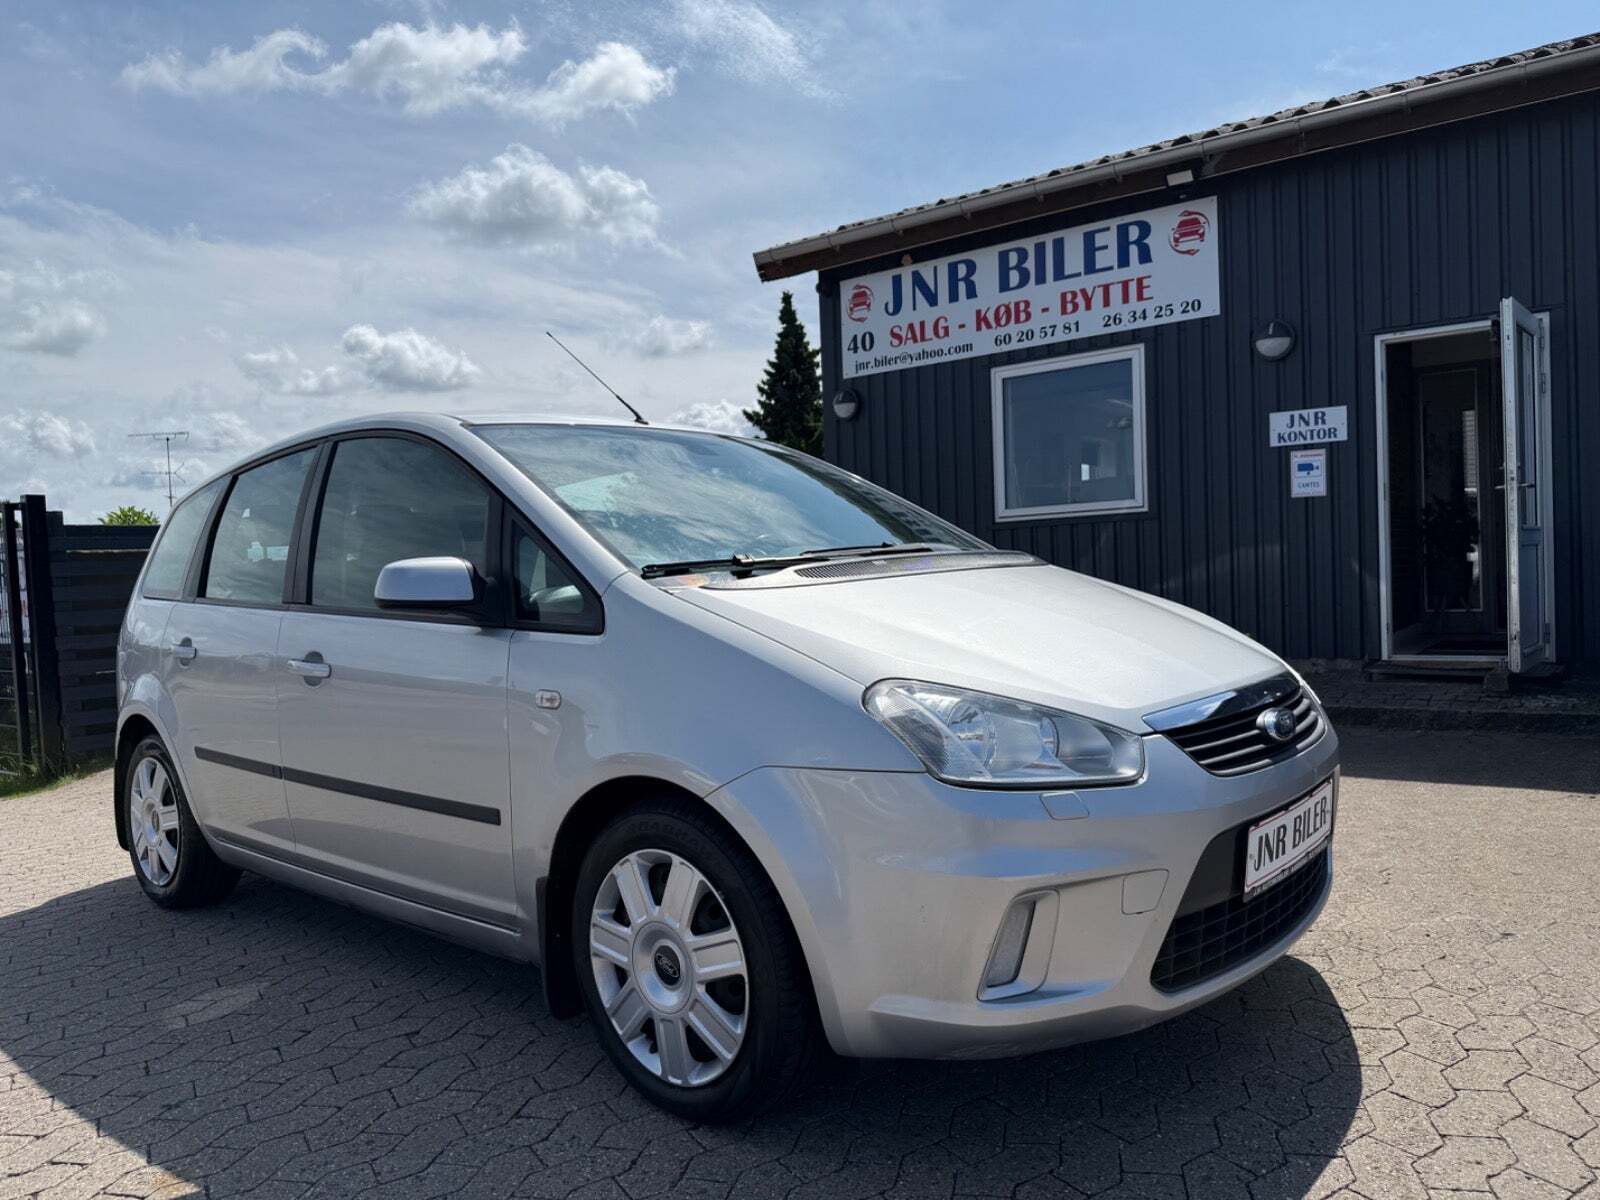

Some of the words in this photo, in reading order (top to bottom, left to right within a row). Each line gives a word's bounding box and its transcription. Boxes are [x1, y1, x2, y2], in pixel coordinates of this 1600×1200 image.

[884, 258, 978, 316] JNR
[998, 220, 1153, 293] BILER
[889, 316, 950, 348] SALG
[975, 299, 1032, 333] KØB
[1060, 275, 1154, 316] BYTTE
[1102, 313, 1122, 328] 26
[1127, 308, 1148, 323] 34
[1153, 303, 1174, 319] 25
[1180, 298, 1202, 314] 20
[847, 331, 875, 354] 40
[994, 333, 1012, 347] 60
[1016, 328, 1034, 343] 20
[1039, 324, 1058, 338] 57
[1062, 320, 1080, 335] 81
[855, 343, 973, 372] jnr.biler@yahoo.com
[1286, 410, 1327, 429] JNR
[1277, 427, 1338, 444] KONTOR
[1253, 824, 1287, 871] JNR
[1292, 796, 1327, 849] BILER
